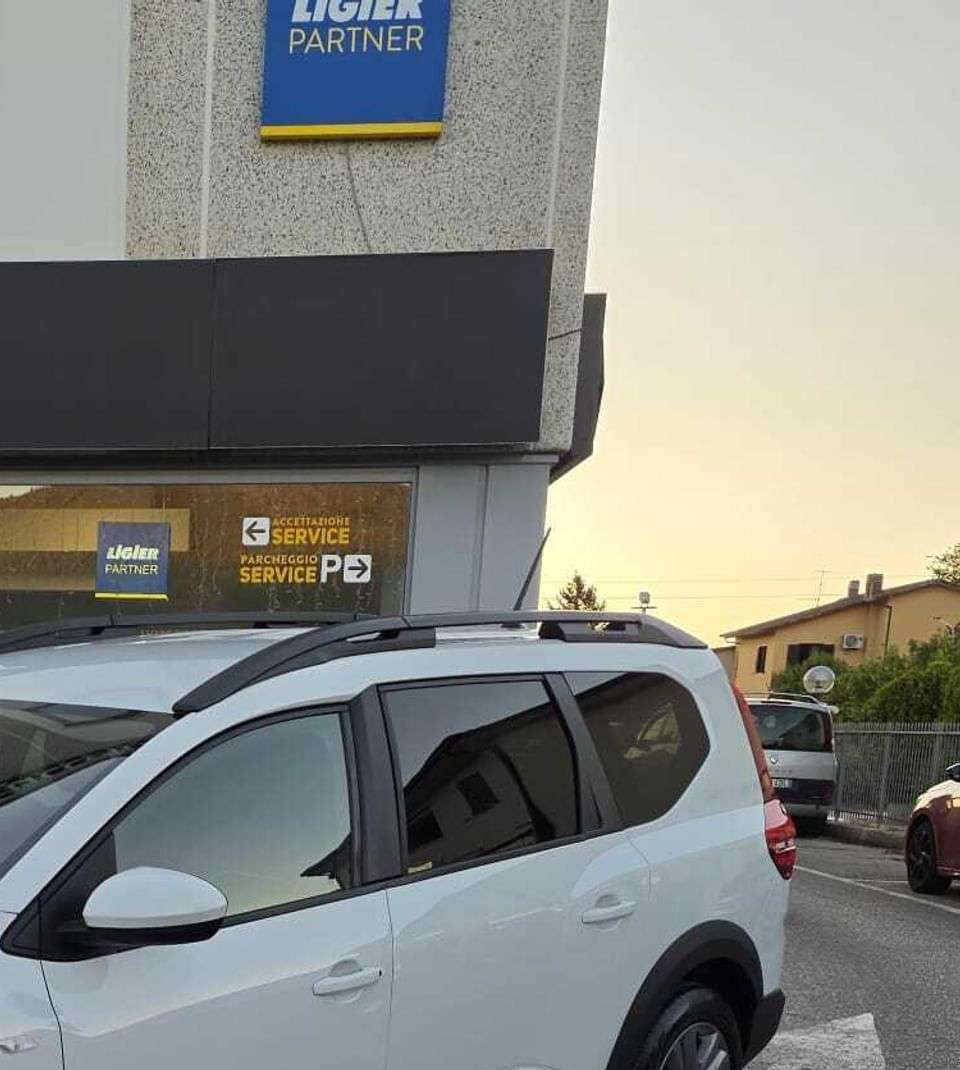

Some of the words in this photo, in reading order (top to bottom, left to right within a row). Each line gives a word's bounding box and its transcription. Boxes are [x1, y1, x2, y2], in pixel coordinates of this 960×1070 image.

[289, 25, 424, 54] PARTNER
[271, 517, 351, 527] ACCETTAZIONE
[271, 528, 351, 546] SERVICE
[239, 554, 319, 565] PARCHEGGIO
[104, 563, 159, 575] PARTNER
[239, 566, 318, 584] SERVICE
[320, 554, 342, 584] P
